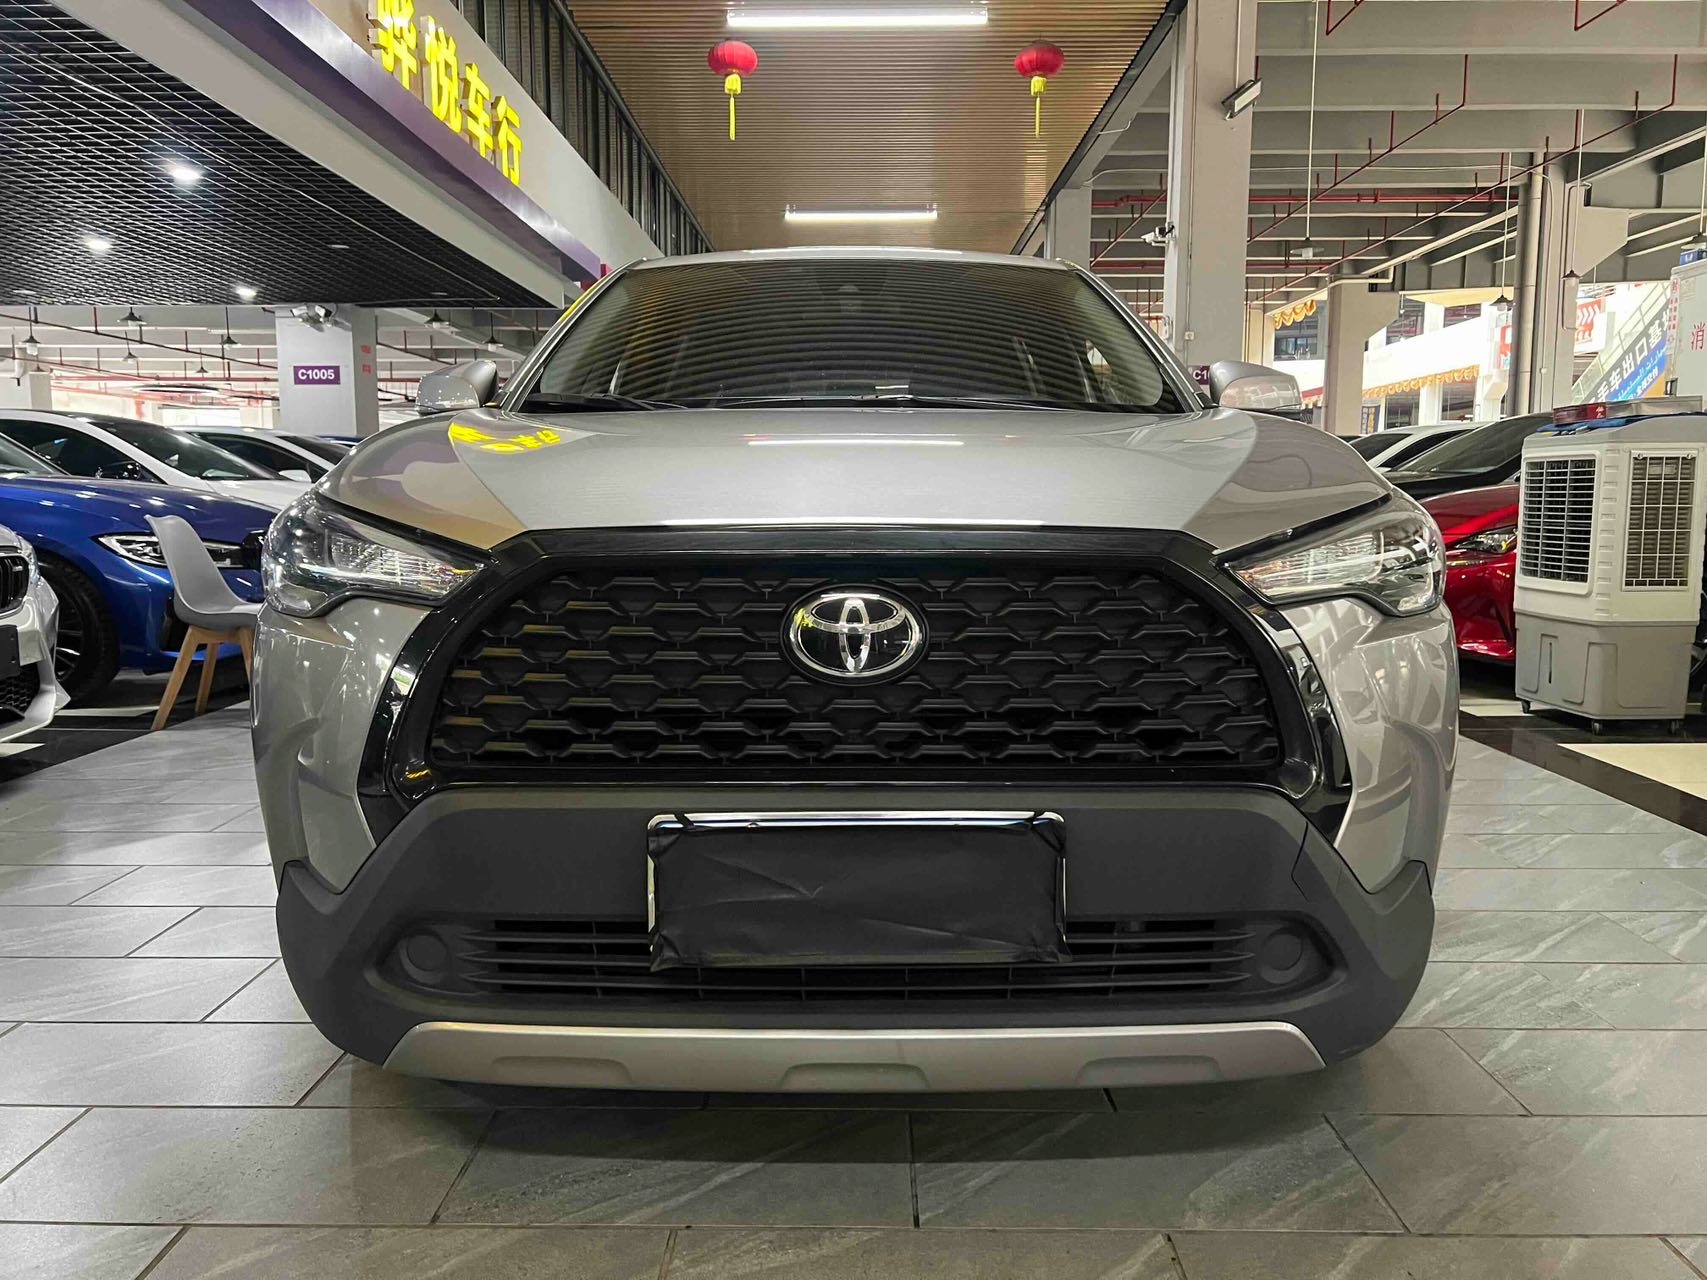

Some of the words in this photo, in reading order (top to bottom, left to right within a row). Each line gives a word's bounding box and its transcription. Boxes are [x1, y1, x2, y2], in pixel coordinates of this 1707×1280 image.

[1691, 321, 1706, 351] 消
[1588, 309, 1669, 403] 手车出口基
[298, 369, 335, 380] C1005
[1192, 370, 1210, 380] C1
